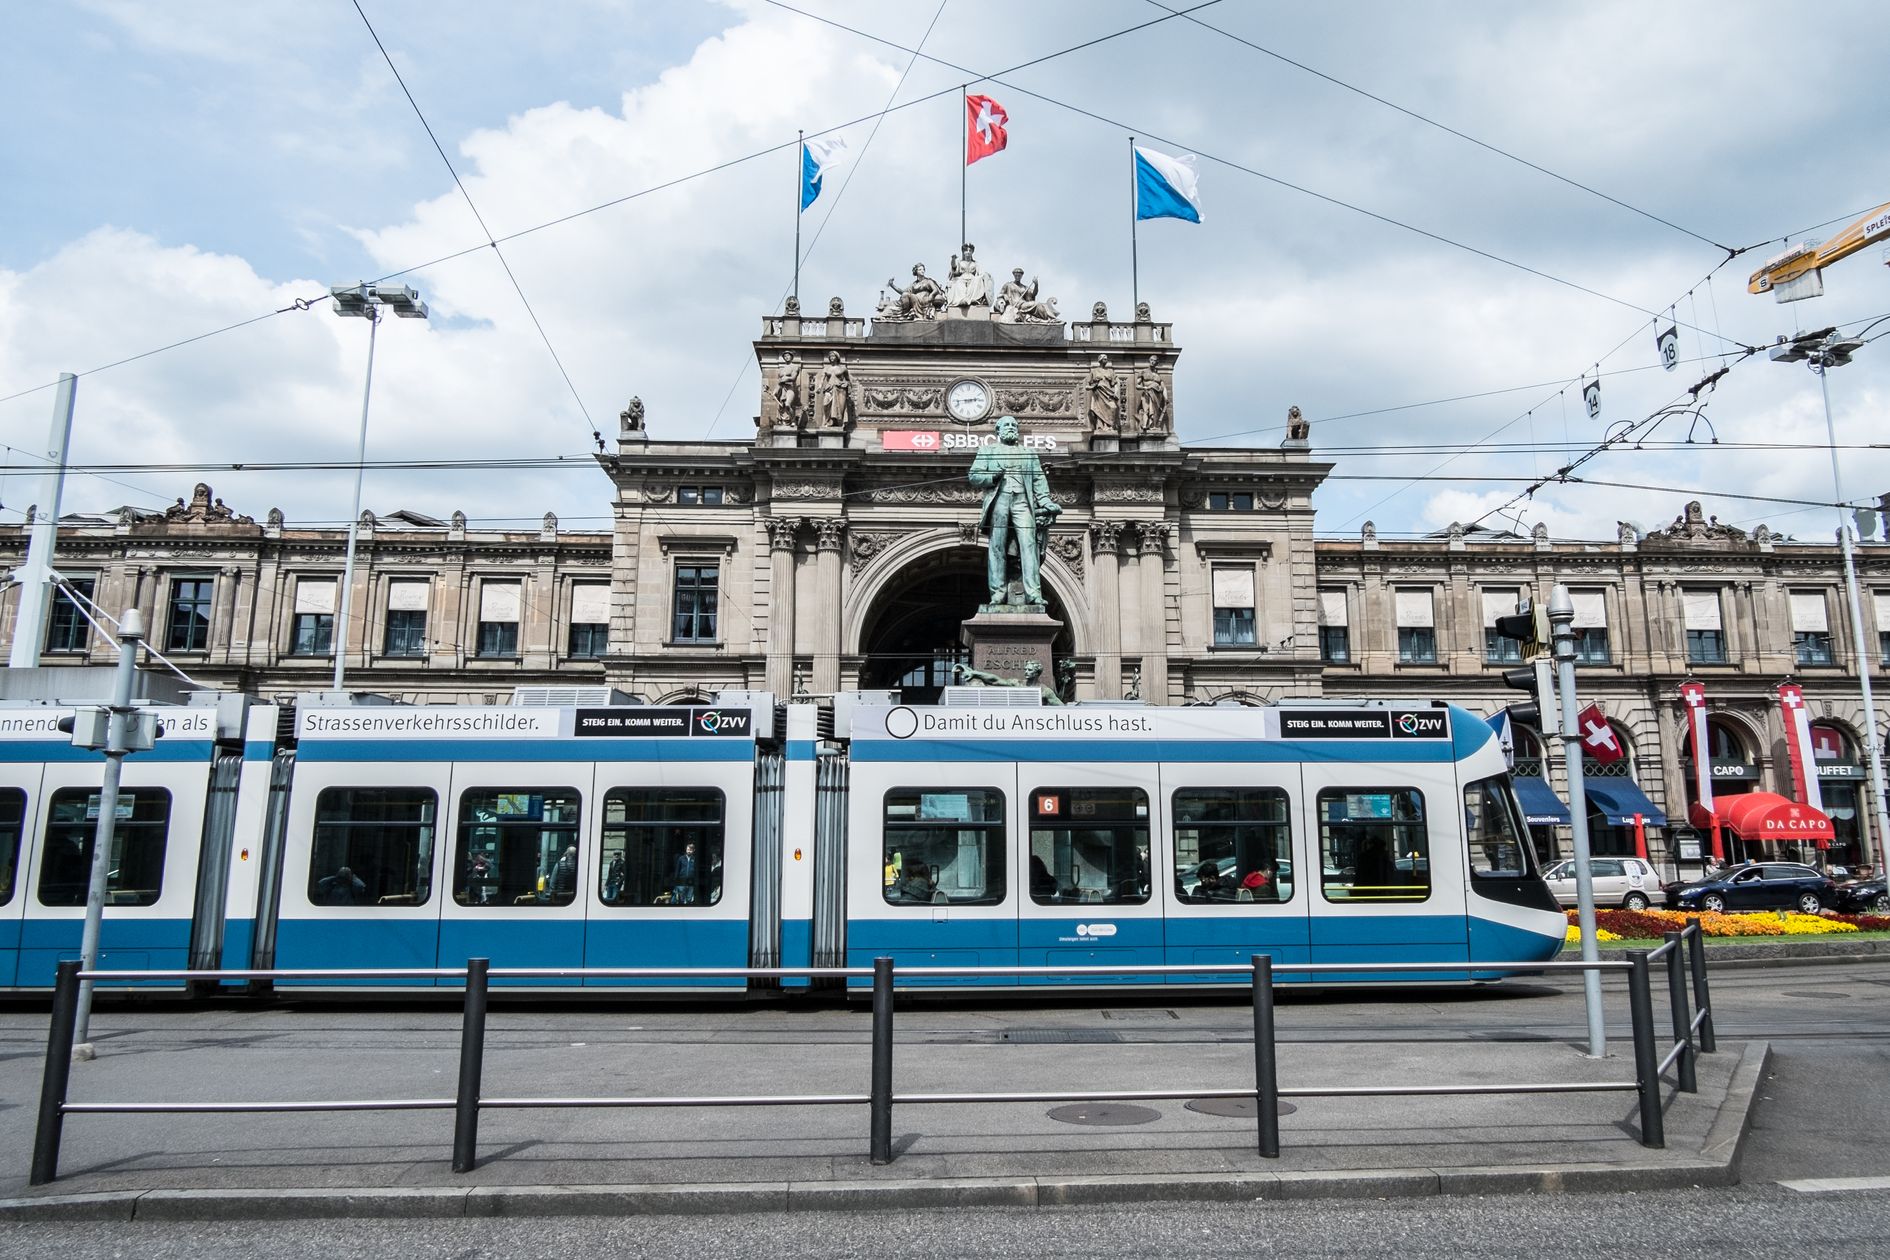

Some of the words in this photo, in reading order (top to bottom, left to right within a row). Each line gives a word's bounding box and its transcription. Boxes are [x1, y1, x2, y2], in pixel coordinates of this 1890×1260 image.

[1663, 342, 1676, 363] 18
[1588, 394, 1598, 411] 14
[943, 433, 979, 448] SBB
[987, 645, 1037, 656] ALFRED
[984, 659, 1029, 671] ESCH
[1, 714, 59, 731] nnend
[182, 713, 208, 731] als
[305, 713, 540, 731] Strassenverkehrsschilder.
[582, 718, 605, 727] STEIG
[607, 718, 623, 727] EIN.
[625, 718, 651, 727] KOMM
[652, 718, 684, 727] WEITER.
[721, 716, 747, 728] ZVV
[924, 713, 978, 731] Damit
[983, 713, 1006, 731] du
[1011, 714, 1103, 731] Anschluss
[1108, 714, 1153, 732] hast.
[1287, 720, 1309, 729] STEIG
[1311, 720, 1326, 729] EIN.
[1328, 720, 1353, 729] KOMM
[1354, 720, 1384, 729] WEITER.
[1419, 719, 1442, 730] ZVV
[1713, 765, 1744, 776] CAPO
[1043, 798, 1054, 812] 6
[1766, 819, 1785, 830] DA
[1788, 819, 1827, 830] CAPO
